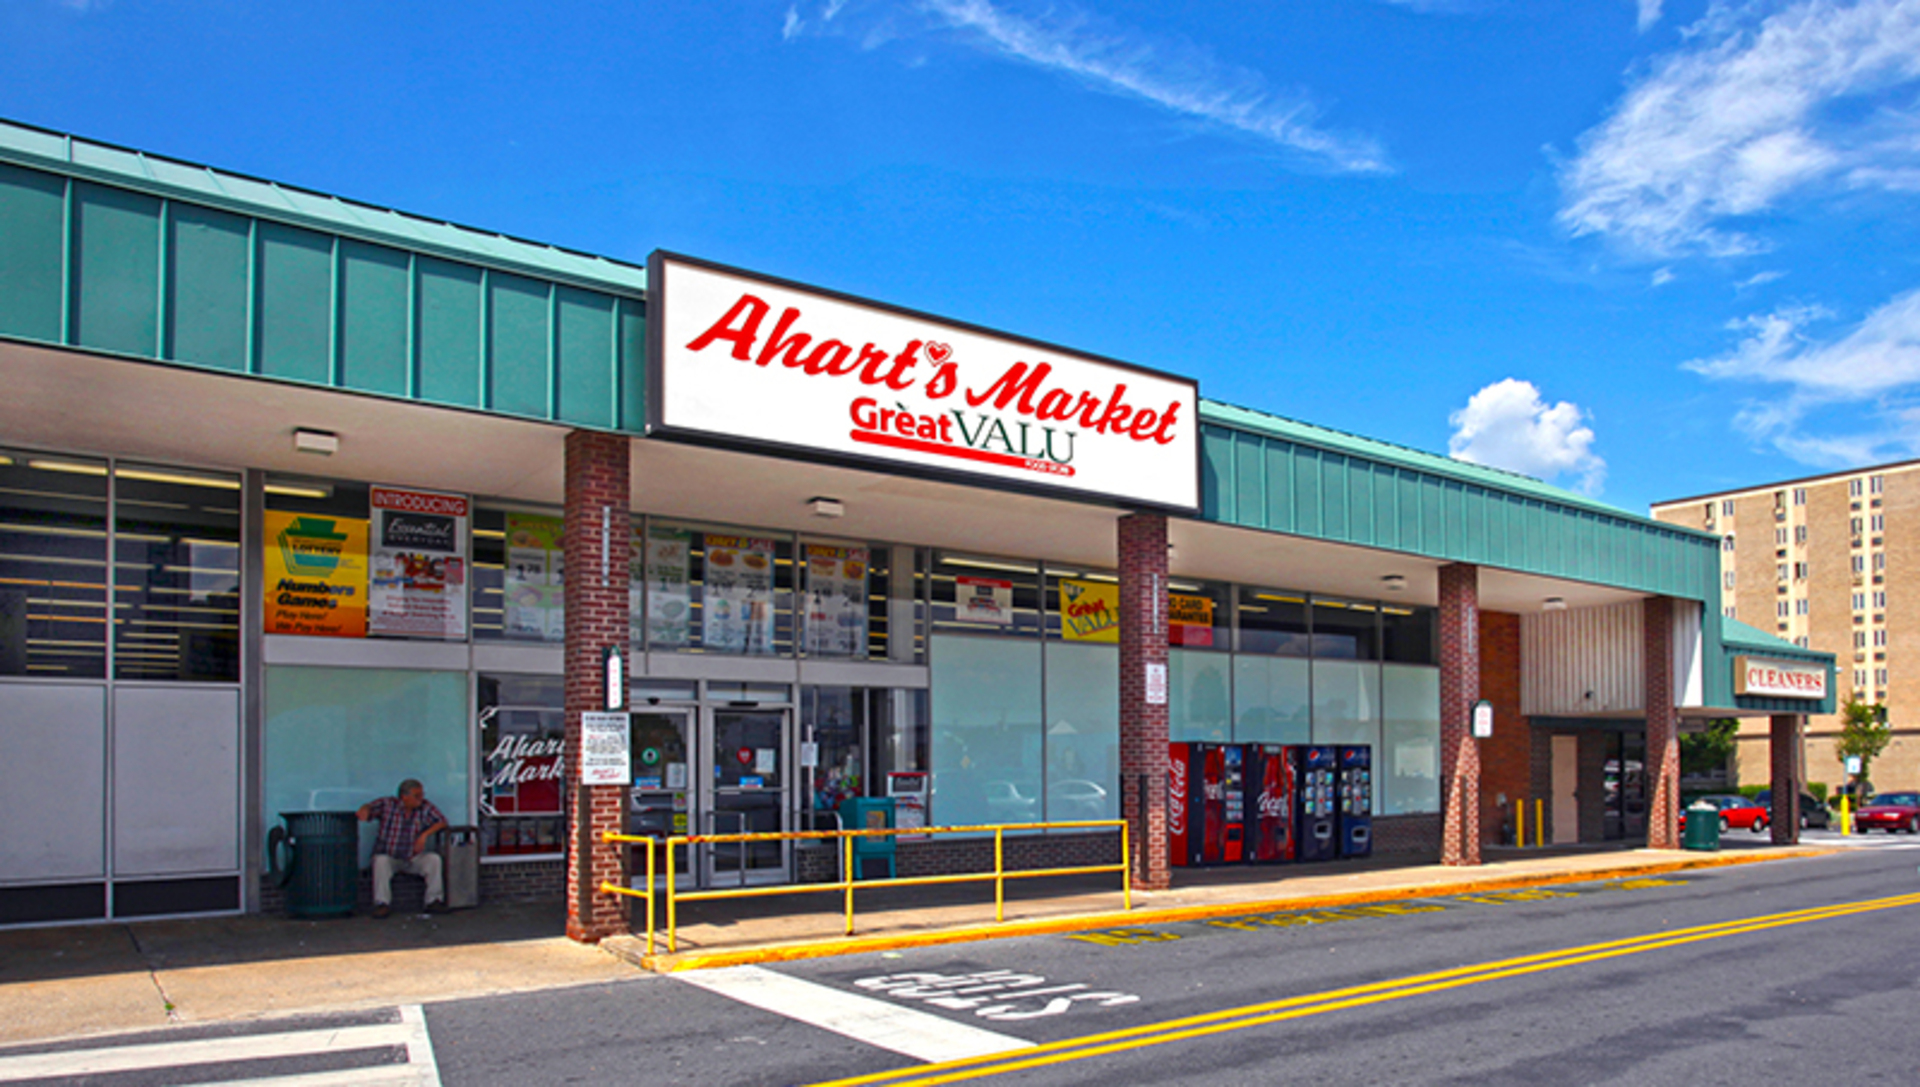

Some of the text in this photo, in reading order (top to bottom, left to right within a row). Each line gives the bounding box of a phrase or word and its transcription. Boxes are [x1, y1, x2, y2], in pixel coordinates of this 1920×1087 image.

[686, 294, 1181, 444] Ahart's Market
[949, 409, 1078, 464] VALU
[374, 491, 464, 514] INTRODUCING
[389, 518, 452, 537] Essential
[276, 578, 355, 596] Numbers
[277, 592, 338, 609] Games
[1067, 598, 1107, 618] Great
[1747, 667, 1823, 690] CLEANERS
